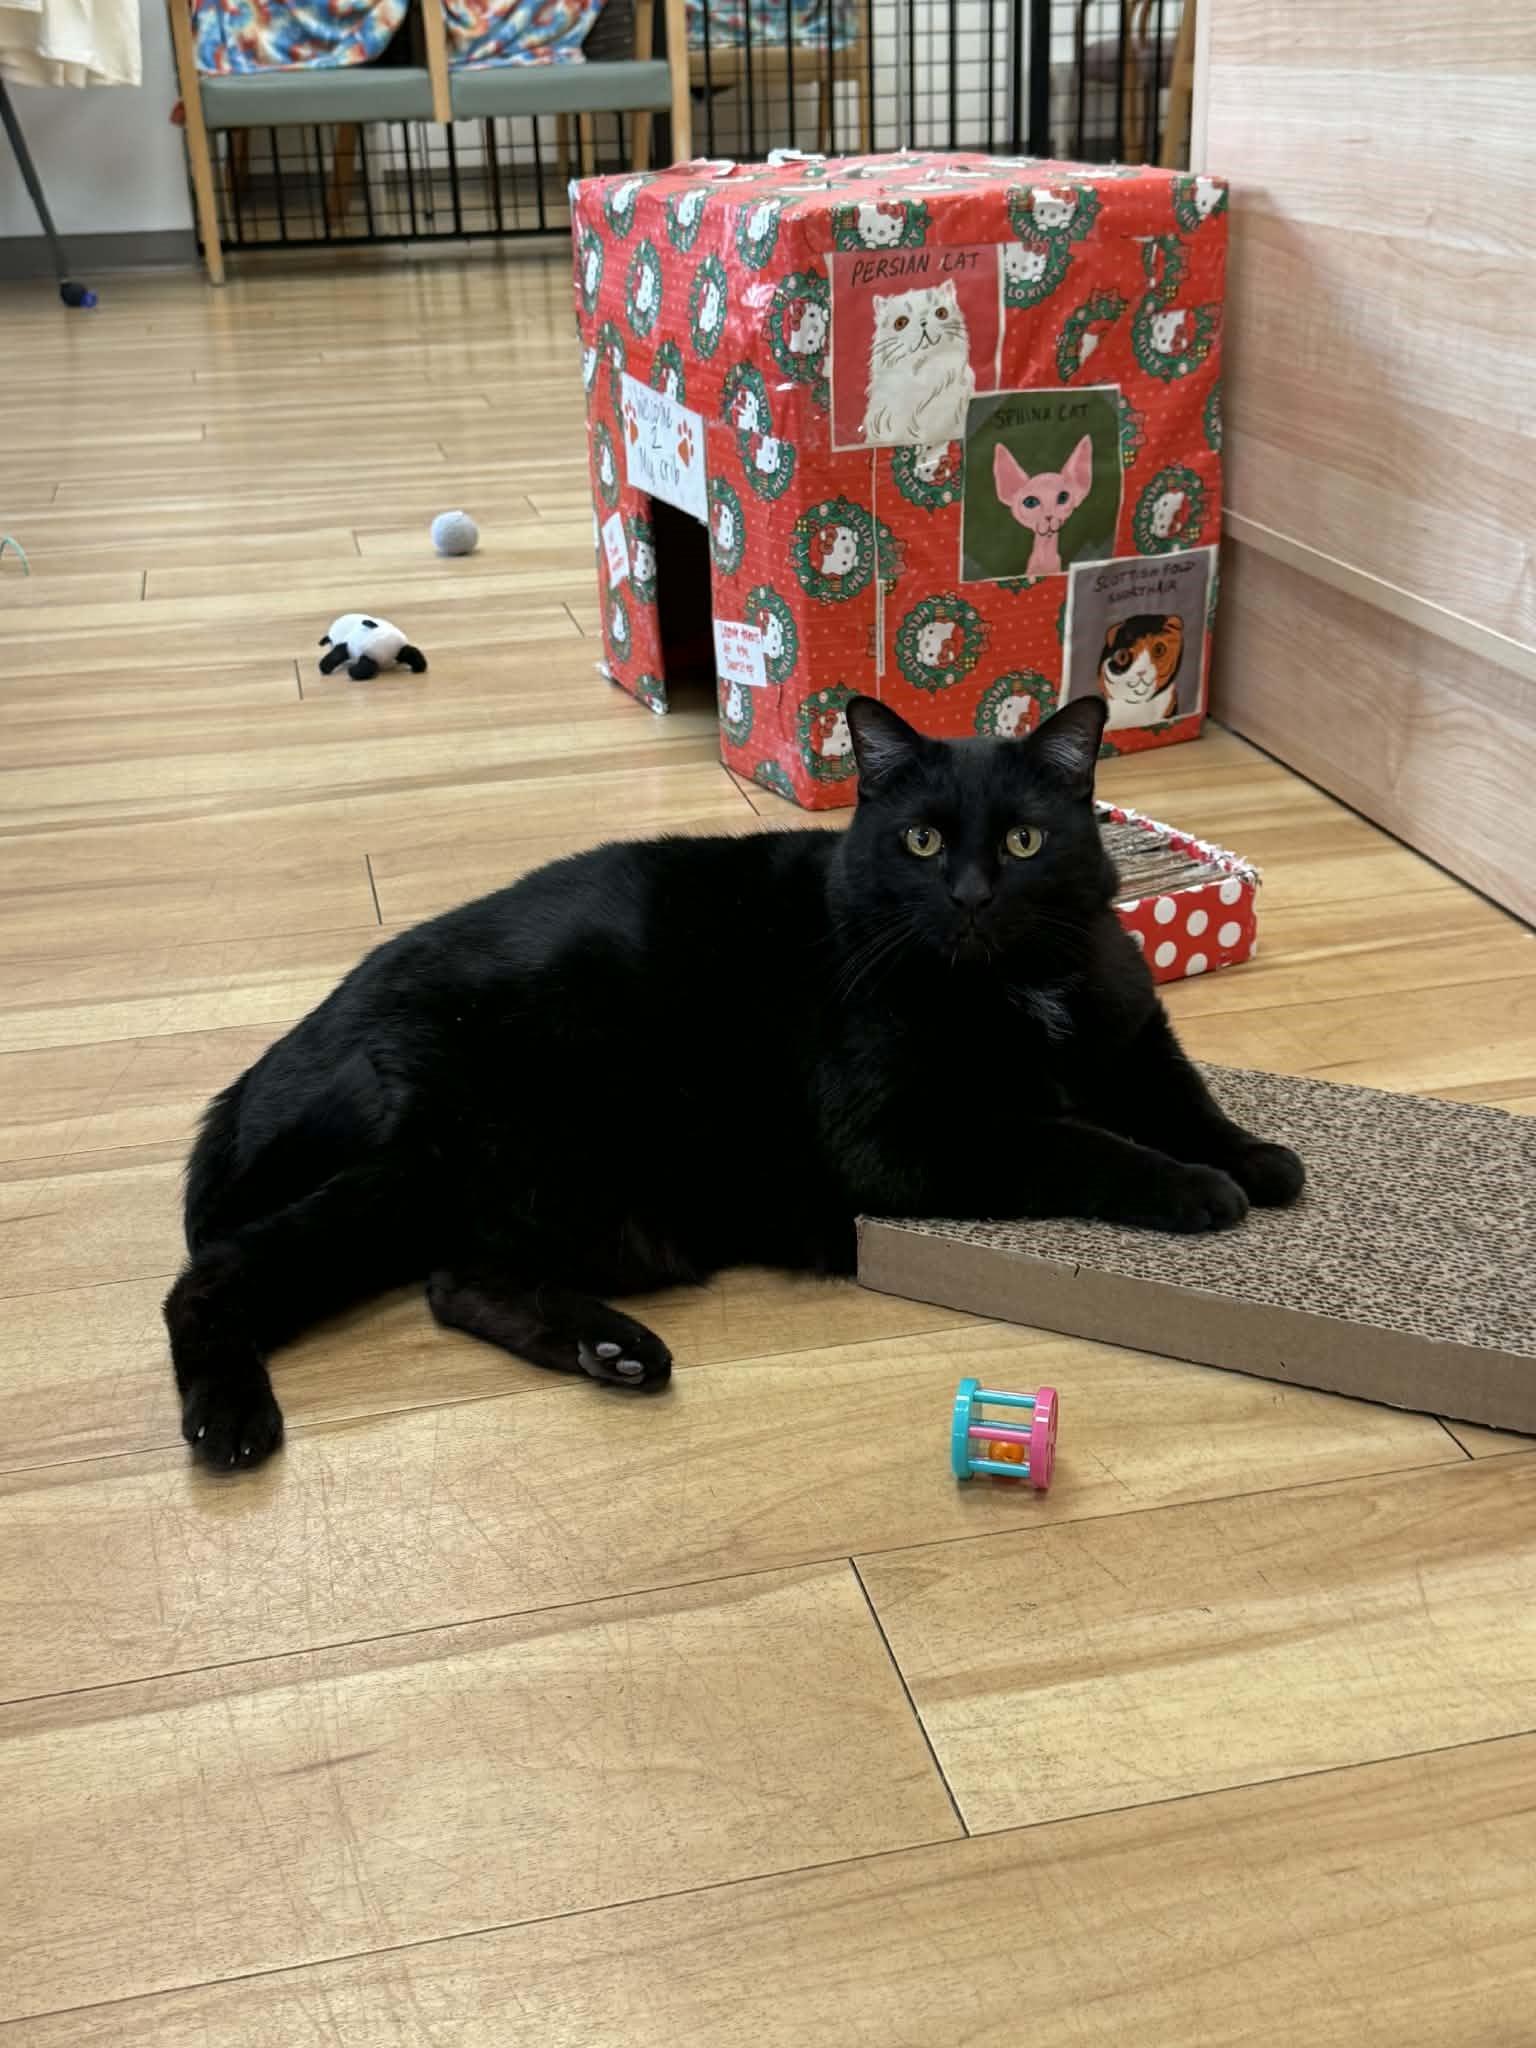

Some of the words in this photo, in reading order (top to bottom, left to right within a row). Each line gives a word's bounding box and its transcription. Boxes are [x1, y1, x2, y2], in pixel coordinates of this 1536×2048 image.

[851, 253, 930, 287] PERSIAN
[942, 252, 980, 273] CAT
[1058, 403, 1089, 422] CAT
[650, 425, 664, 449] 2
[848, 510, 873, 546] KITTY
[848, 550, 872, 591] HELLO
[903, 606, 929, 647] HELLO
[903, 650, 928, 681] KITTY
